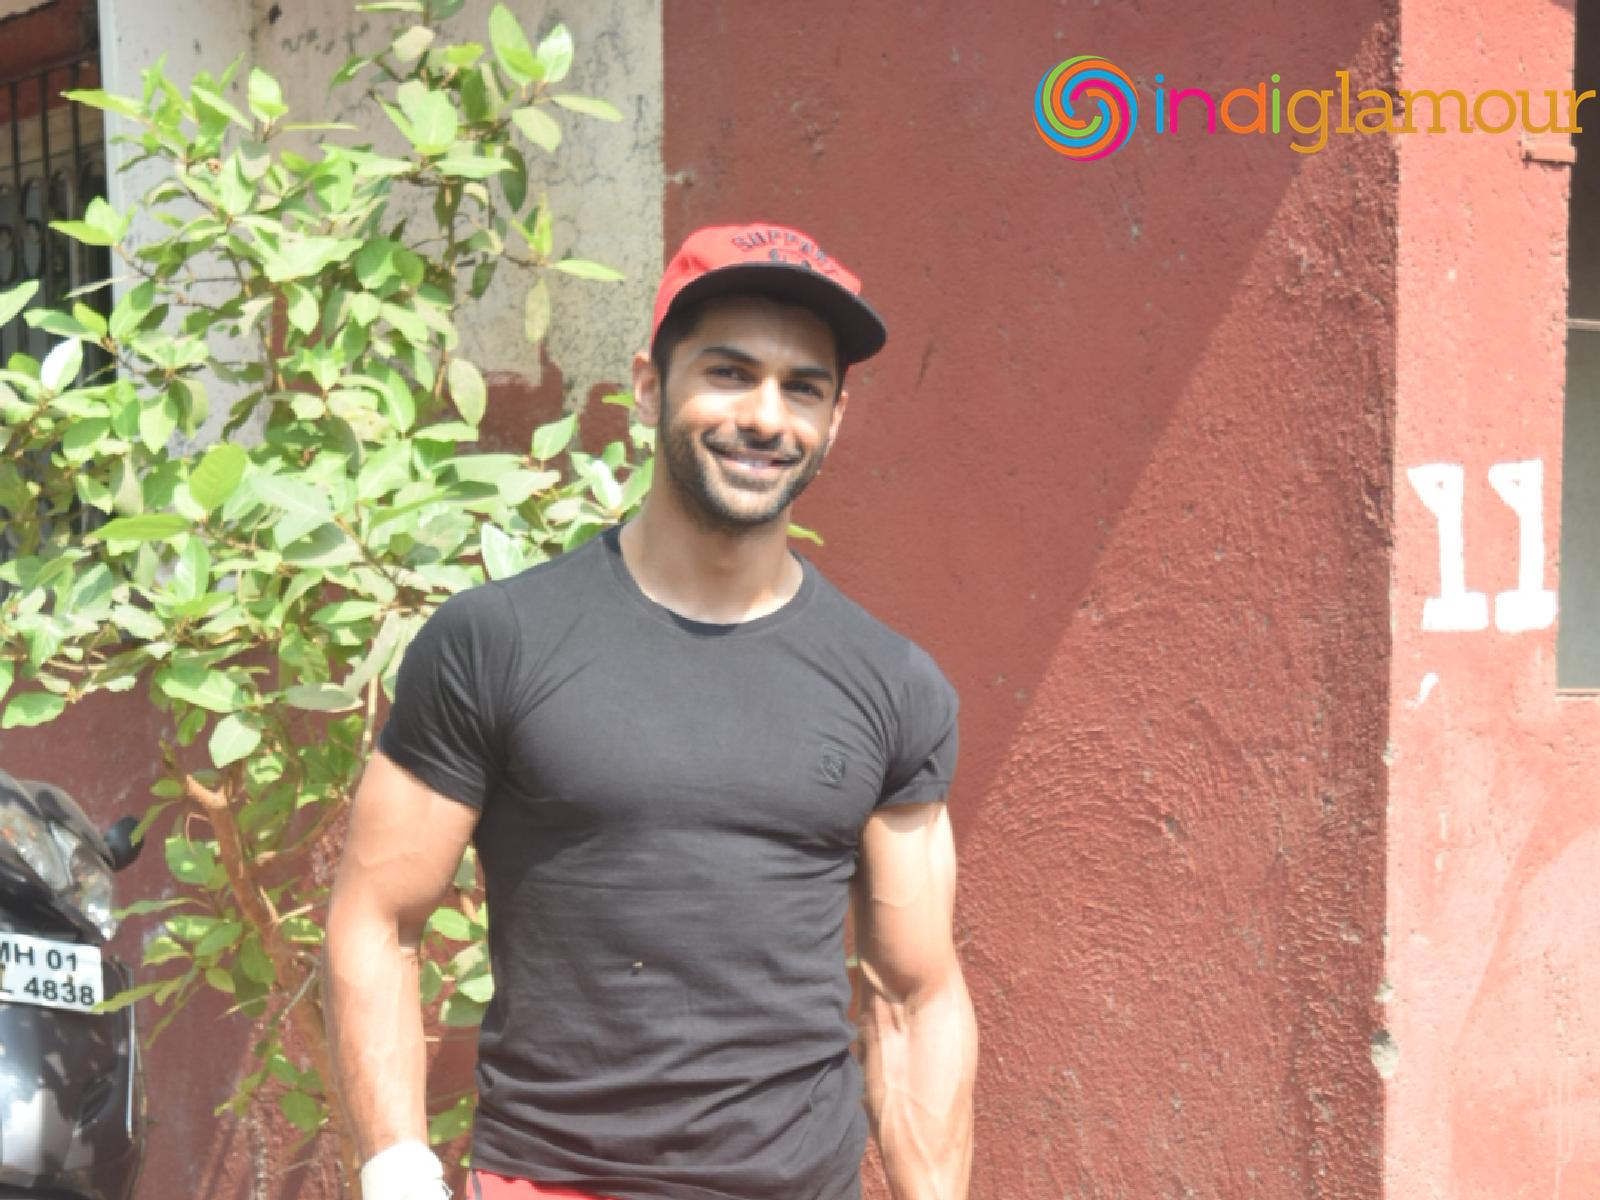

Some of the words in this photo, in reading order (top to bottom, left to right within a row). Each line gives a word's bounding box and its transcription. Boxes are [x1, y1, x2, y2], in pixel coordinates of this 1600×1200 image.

[1406, 457, 1558, 633] 11
[46, 949, 77, 972] 01
[23, 976, 95, 1006] 4838
